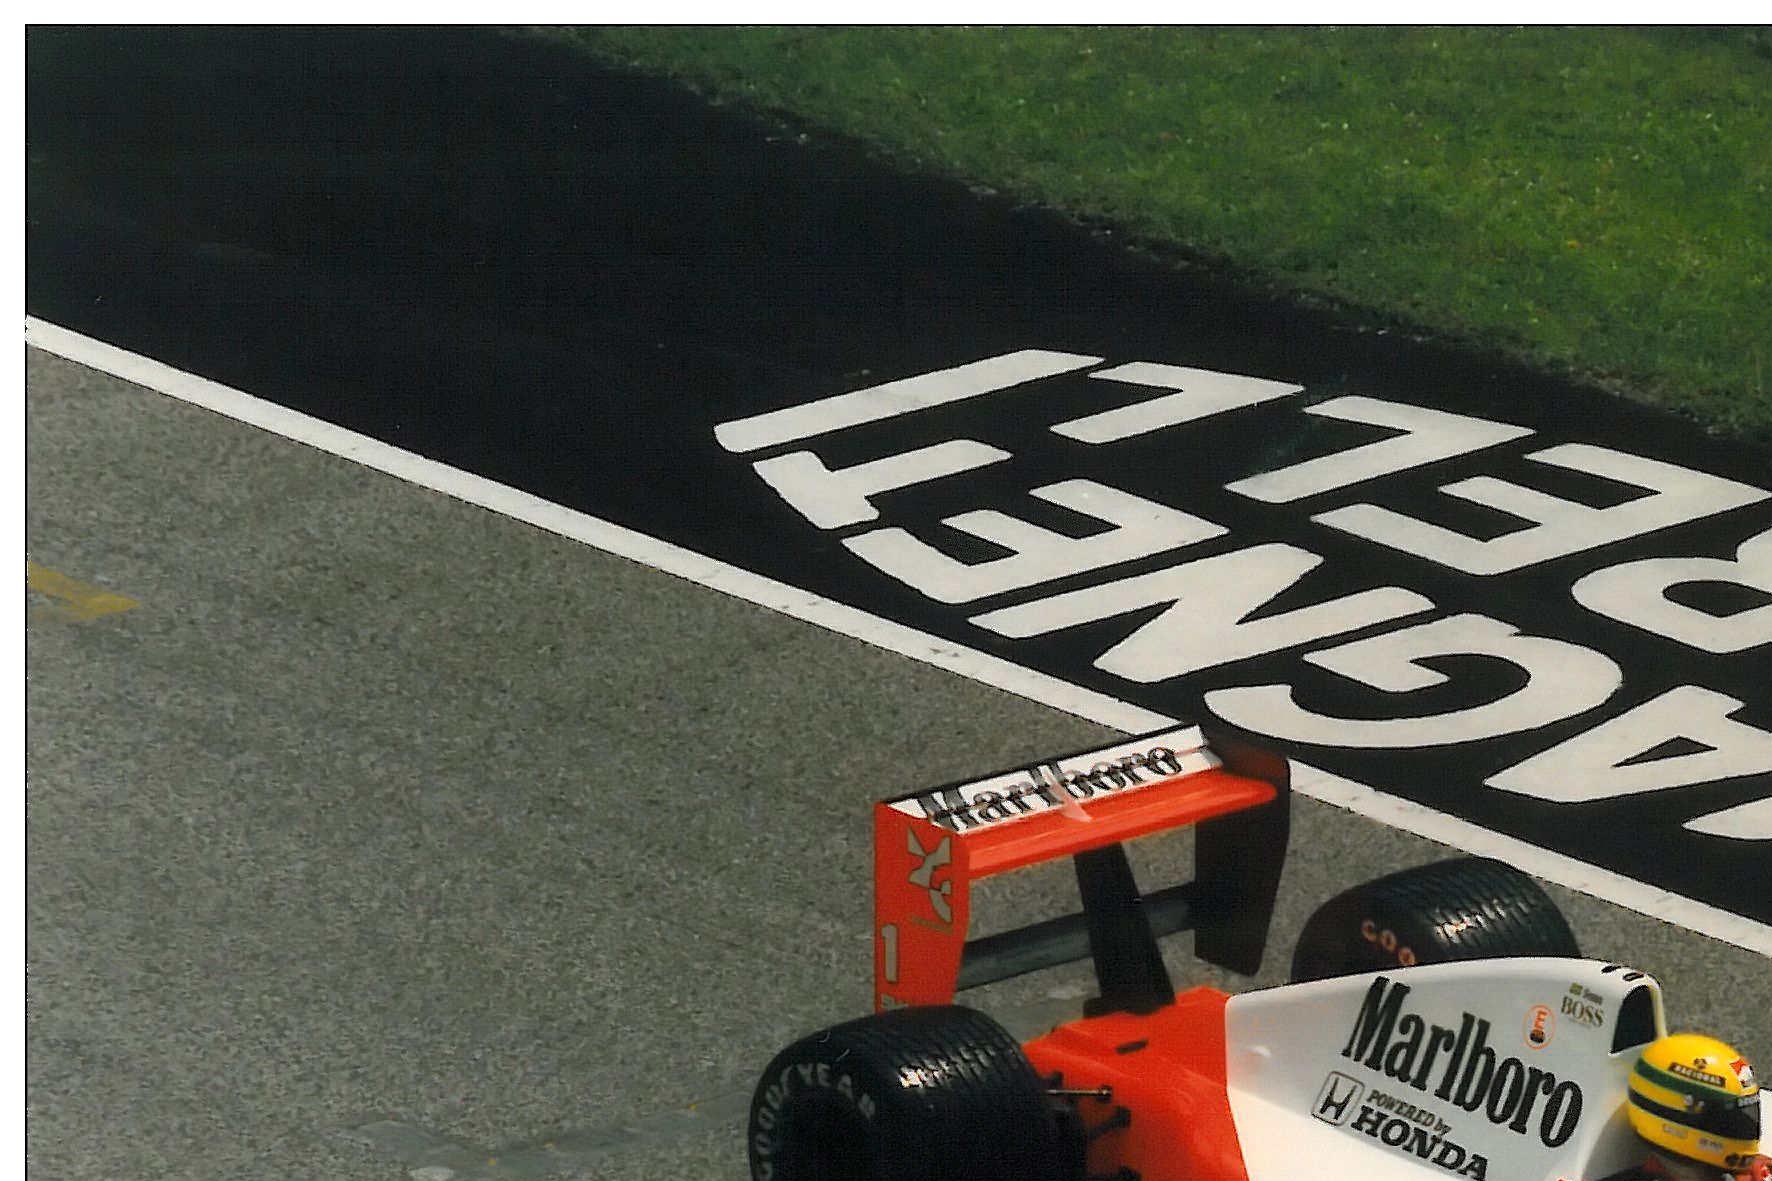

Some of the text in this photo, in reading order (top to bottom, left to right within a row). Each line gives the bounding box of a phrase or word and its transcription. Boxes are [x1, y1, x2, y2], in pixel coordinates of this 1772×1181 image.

[916, 747, 1184, 832] Marlboro
[1561, 995, 1604, 1029] BOSS
[1341, 975, 1584, 1148] Marlboro
[1366, 1089, 1454, 1136] POWERED by
